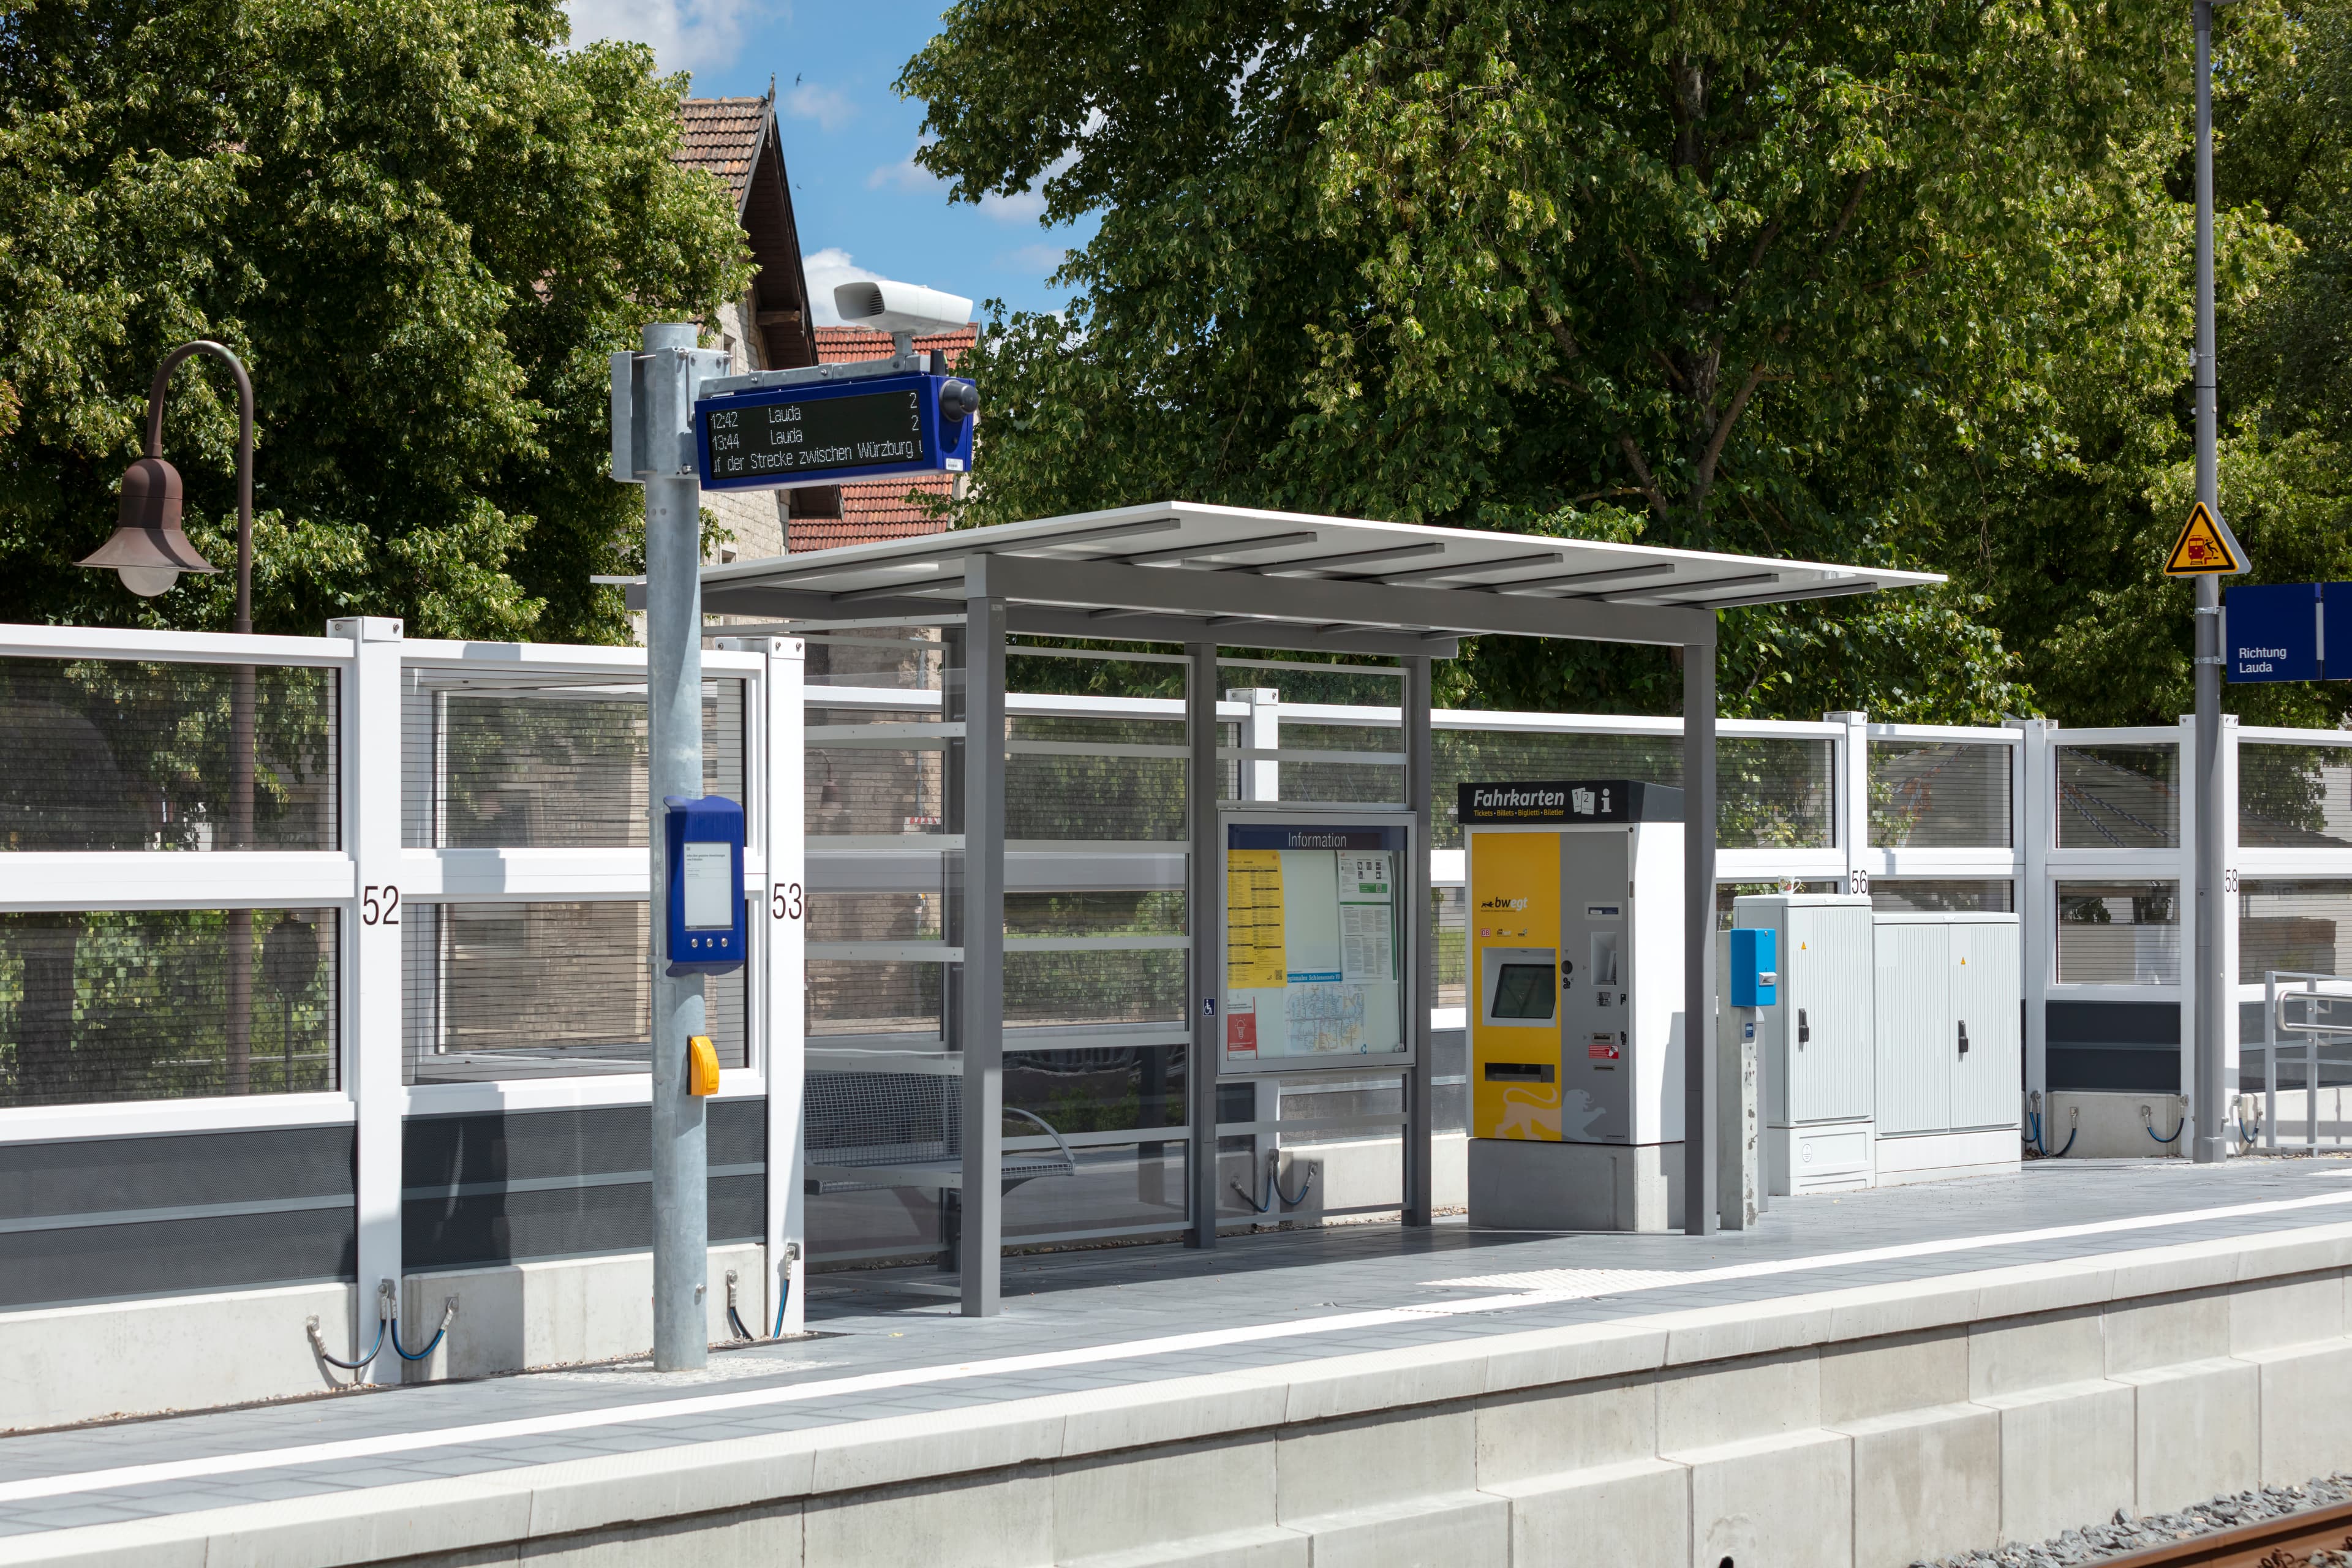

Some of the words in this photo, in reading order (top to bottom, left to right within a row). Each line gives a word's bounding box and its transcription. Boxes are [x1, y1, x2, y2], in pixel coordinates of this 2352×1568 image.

[710, 411, 739, 429] 12:42
[769, 405, 801, 423] Lauda
[910, 392, 918, 409] 2
[712, 433, 740, 451] 13:44
[770, 428, 803, 445] Lauda
[911, 415, 919, 431] 2
[727, 455, 744, 472] der
[750, 451, 794, 469] Strecke
[799, 445, 853, 464] zwischen
[857, 440, 914, 459] Würzburg
[2239, 647, 2286, 660] Richtung
[2239, 662, 2274, 673] Lauda
[1474, 788, 1564, 807] Fahrkarten
[1518, 809, 1540, 818] Biglietti
[1288, 831, 1346, 848] Information
[1852, 869, 1868, 894] 56
[2225, 869, 2238, 892] 58
[363, 885, 399, 925] 52
[772, 883, 802, 919] 53
[1494, 896, 1528, 911] bwegt
